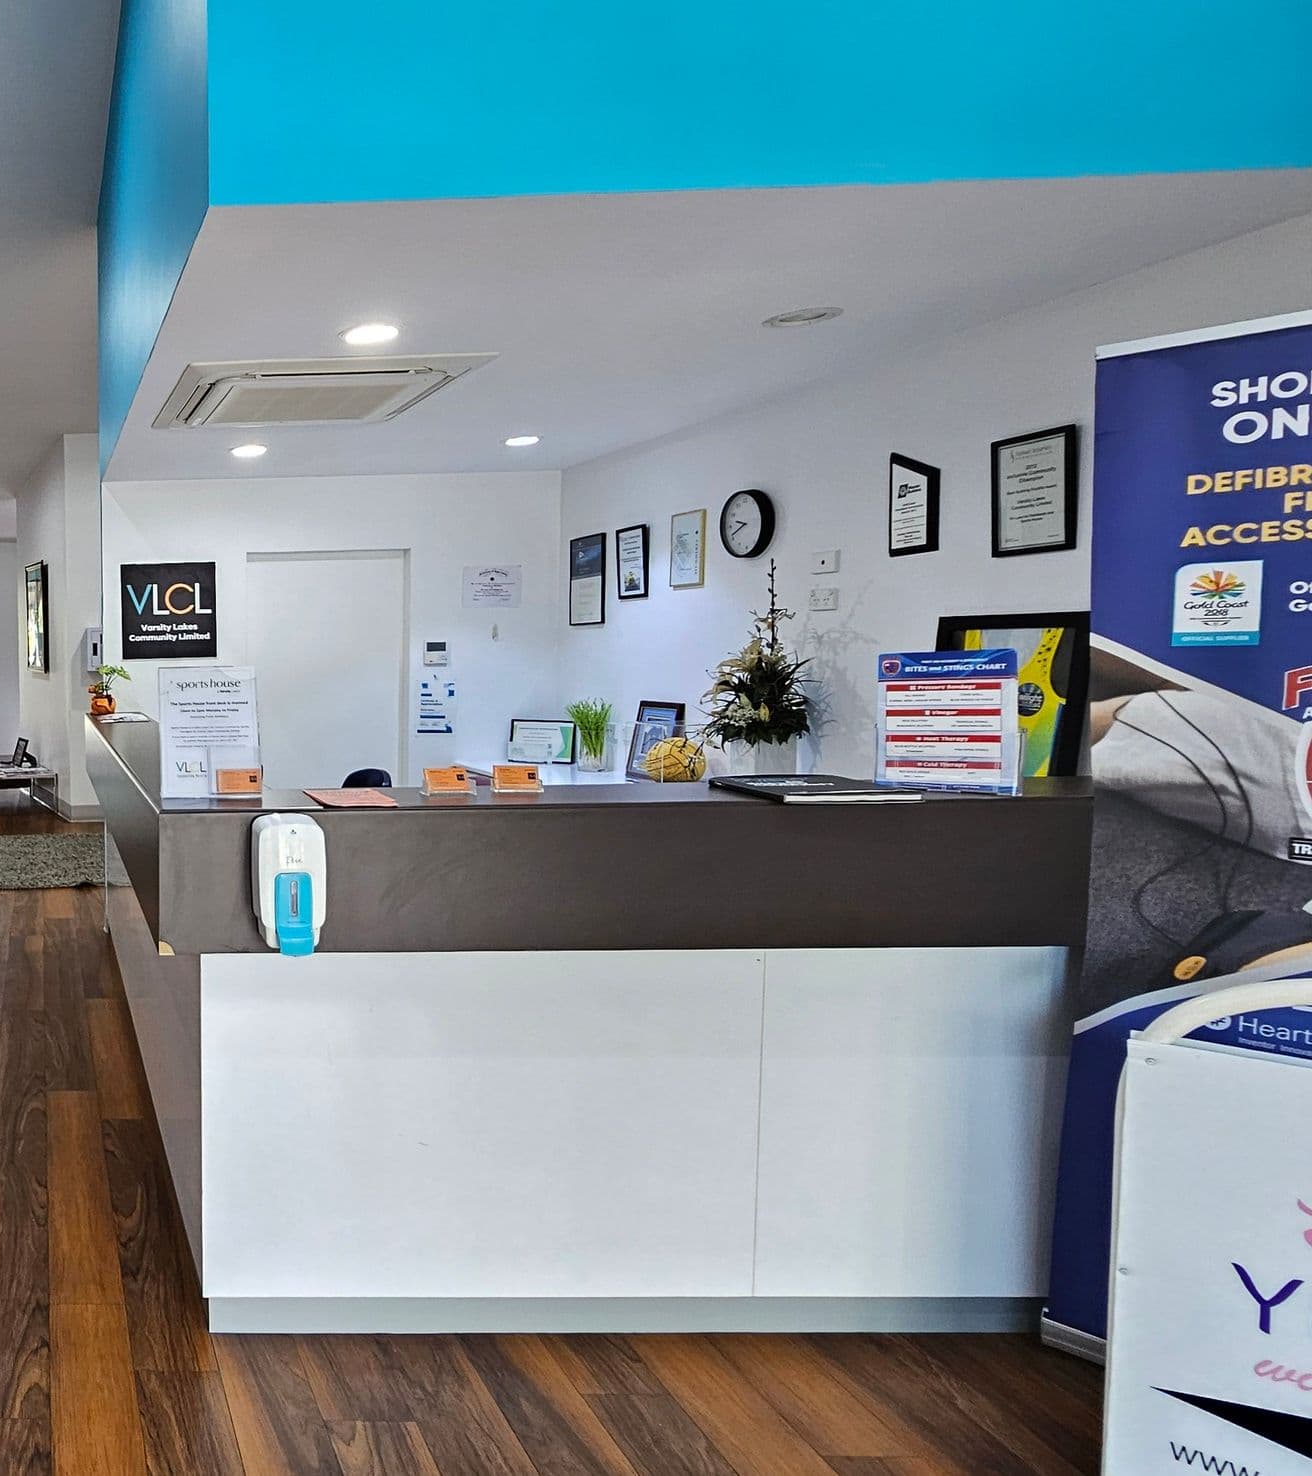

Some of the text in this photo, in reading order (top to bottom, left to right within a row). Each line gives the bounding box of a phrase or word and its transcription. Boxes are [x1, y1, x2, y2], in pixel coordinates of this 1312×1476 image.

[1210, 371, 1312, 408] SHO
[1187, 464, 1312, 495] DEFIBR
[126, 582, 212, 616] VLCL
[1184, 600, 1249, 610] Gold Coast
[141, 622, 198, 632] Varsity Lakes
[128, 632, 211, 641] Community Limited
[943, 664, 975, 672] STINGS
